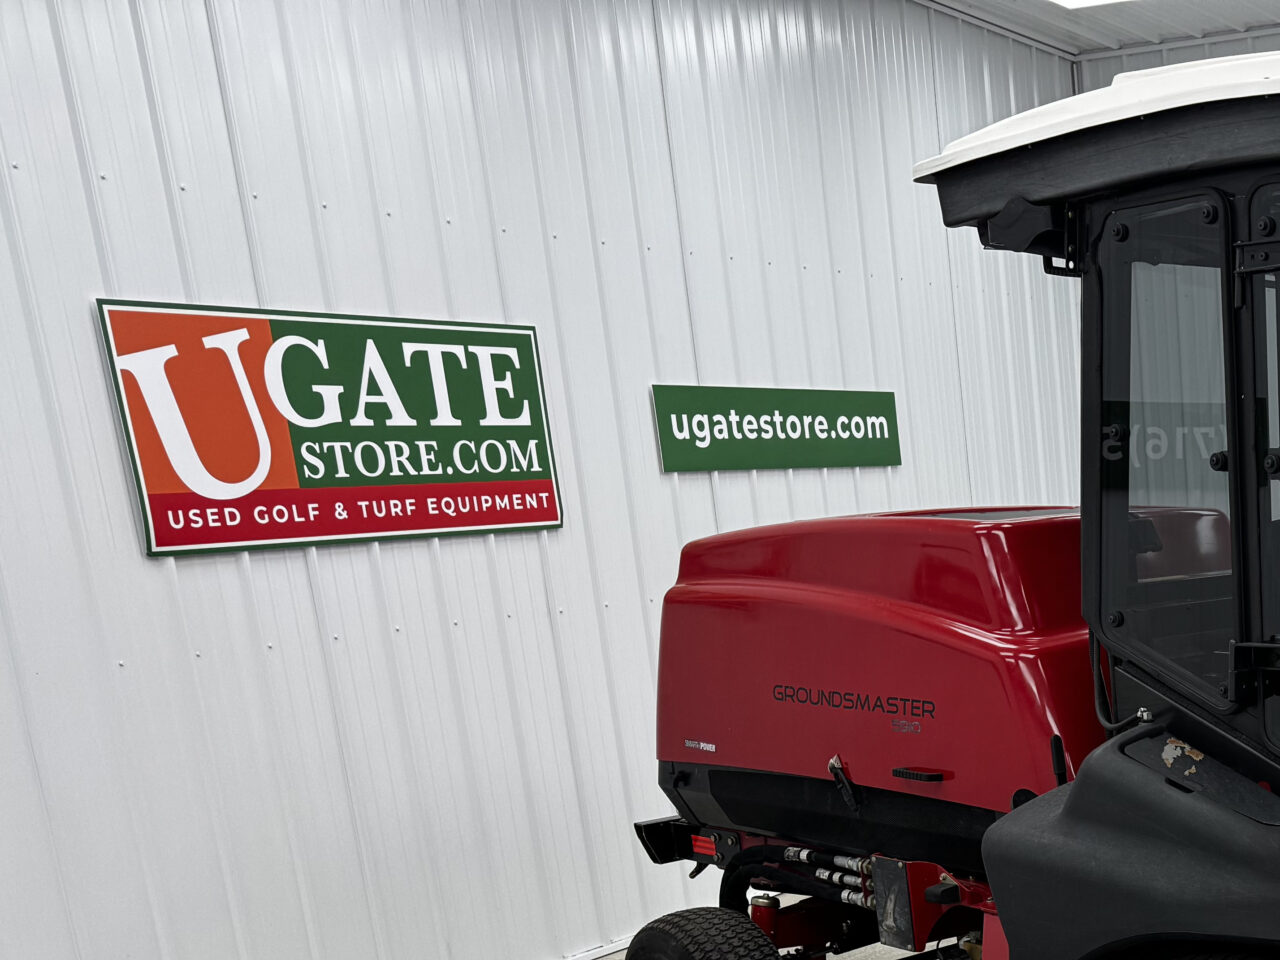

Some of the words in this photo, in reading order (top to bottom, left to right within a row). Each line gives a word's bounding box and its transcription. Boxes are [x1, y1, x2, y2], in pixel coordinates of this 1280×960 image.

[671, 409, 889, 448] ugatestore.com
[300, 438, 543, 480] STORE.COM
[167, 507, 242, 529] USED
[253, 503, 320, 525] GOLF
[334, 502, 349, 520] &
[357, 498, 417, 518] TURF
[427, 492, 549, 516] EQUIPMENT
[772, 684, 936, 719] GROUNDSMASTER
